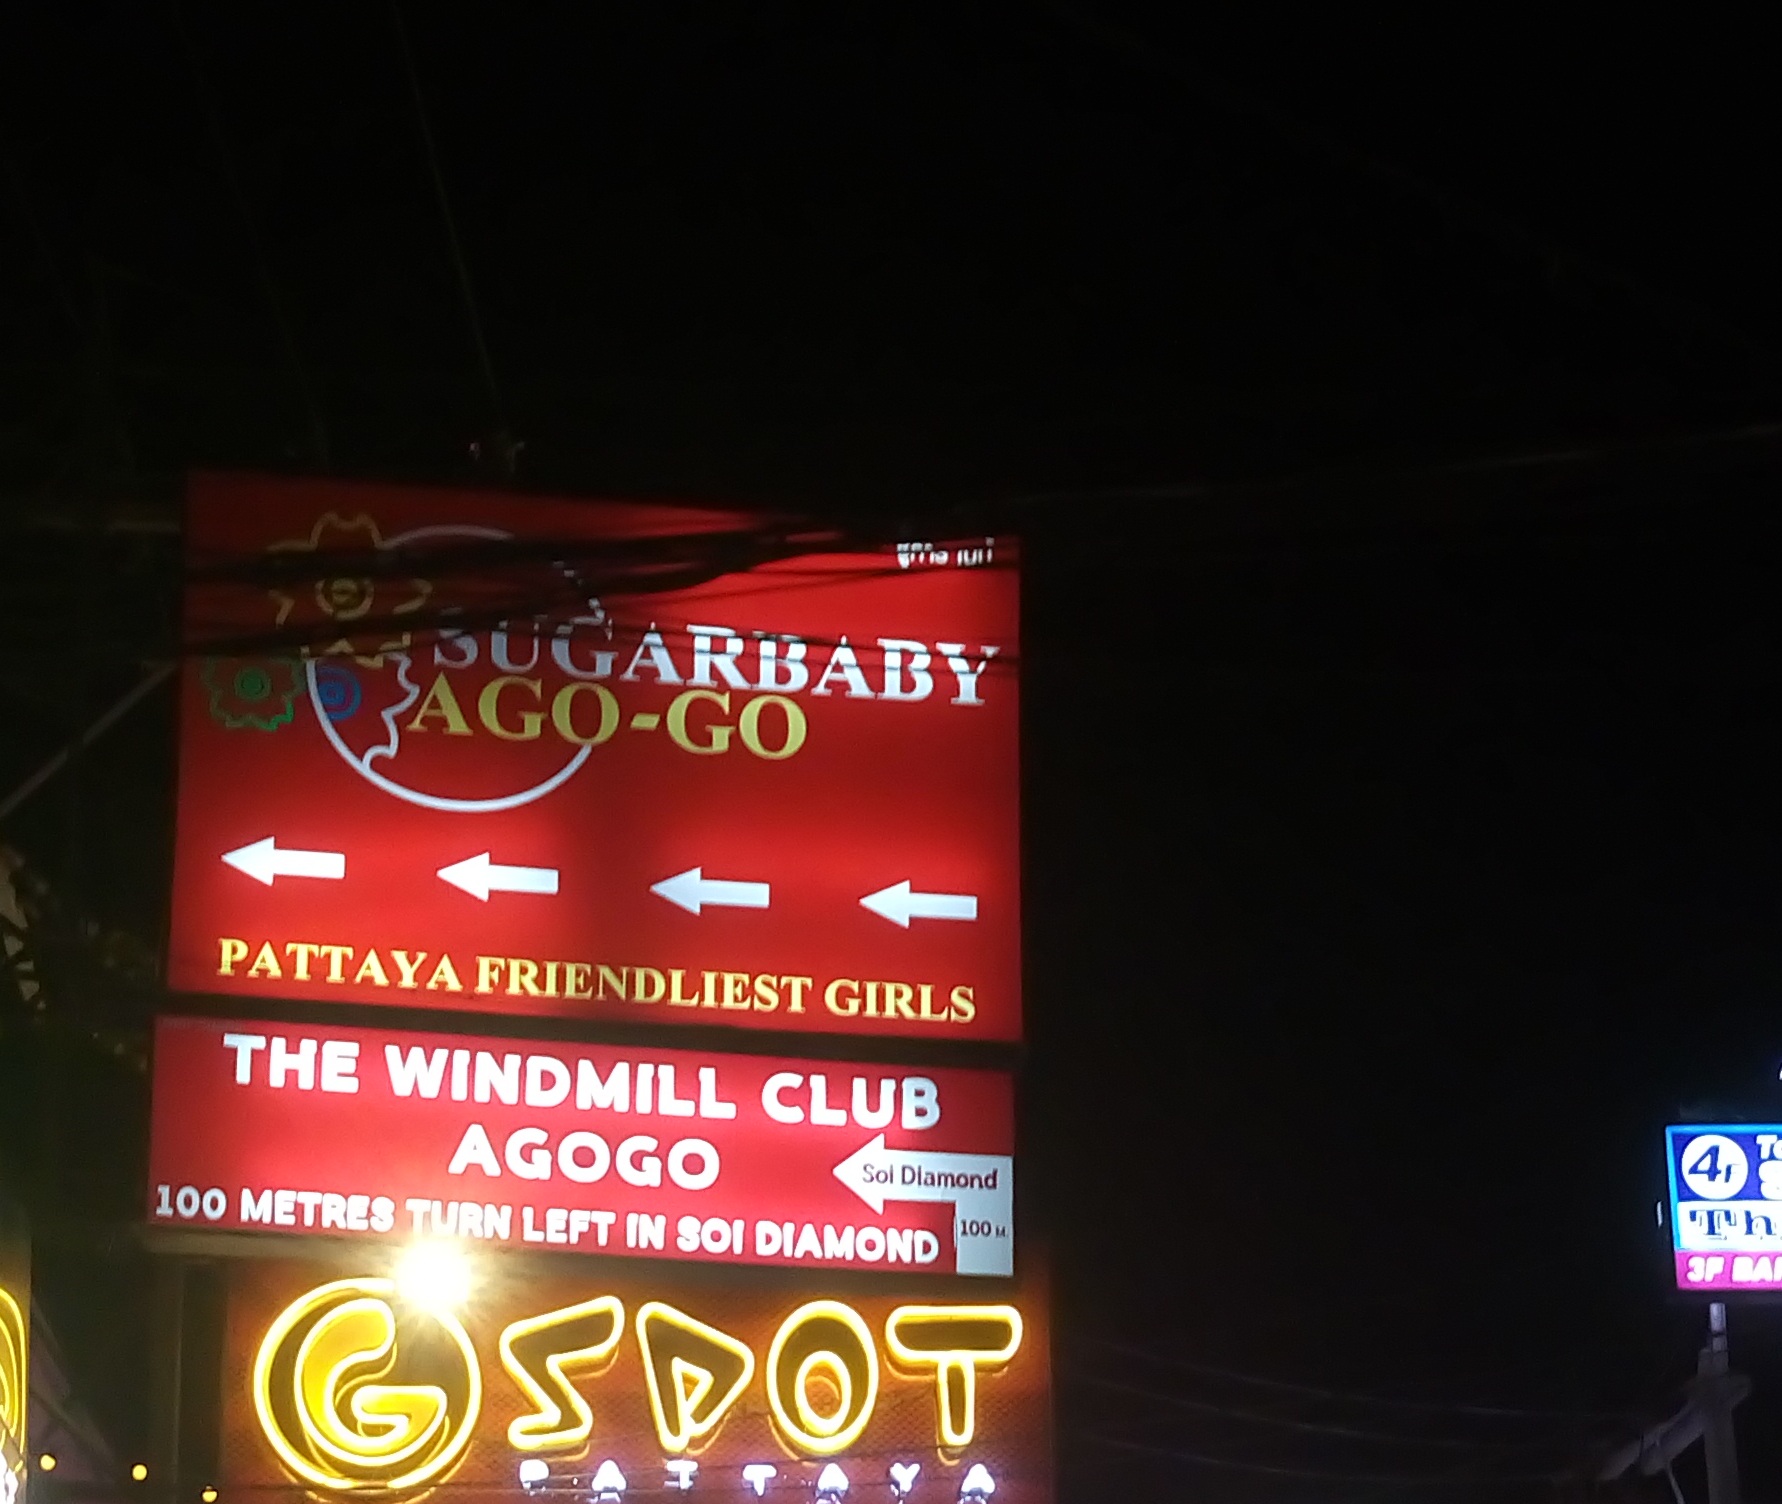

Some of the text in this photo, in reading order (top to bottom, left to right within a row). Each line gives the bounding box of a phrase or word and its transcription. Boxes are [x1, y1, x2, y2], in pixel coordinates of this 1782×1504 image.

[431, 617, 1000, 706] SUGARBABY
[406, 674, 809, 760] AGO-GO
[218, 938, 977, 1023] PATTAYA FRIENDLIEST GIRLS
[223, 1034, 942, 1131] THE WINDMILL CLUB
[447, 1123, 721, 1191] AGOGO
[862, 1163, 999, 1192] Soi Diamond
[156, 1184, 940, 1265] 100 METRES TURN LEFT IN SOI DIAMOND
[1687, 1256, 1722, 1283] 3F
